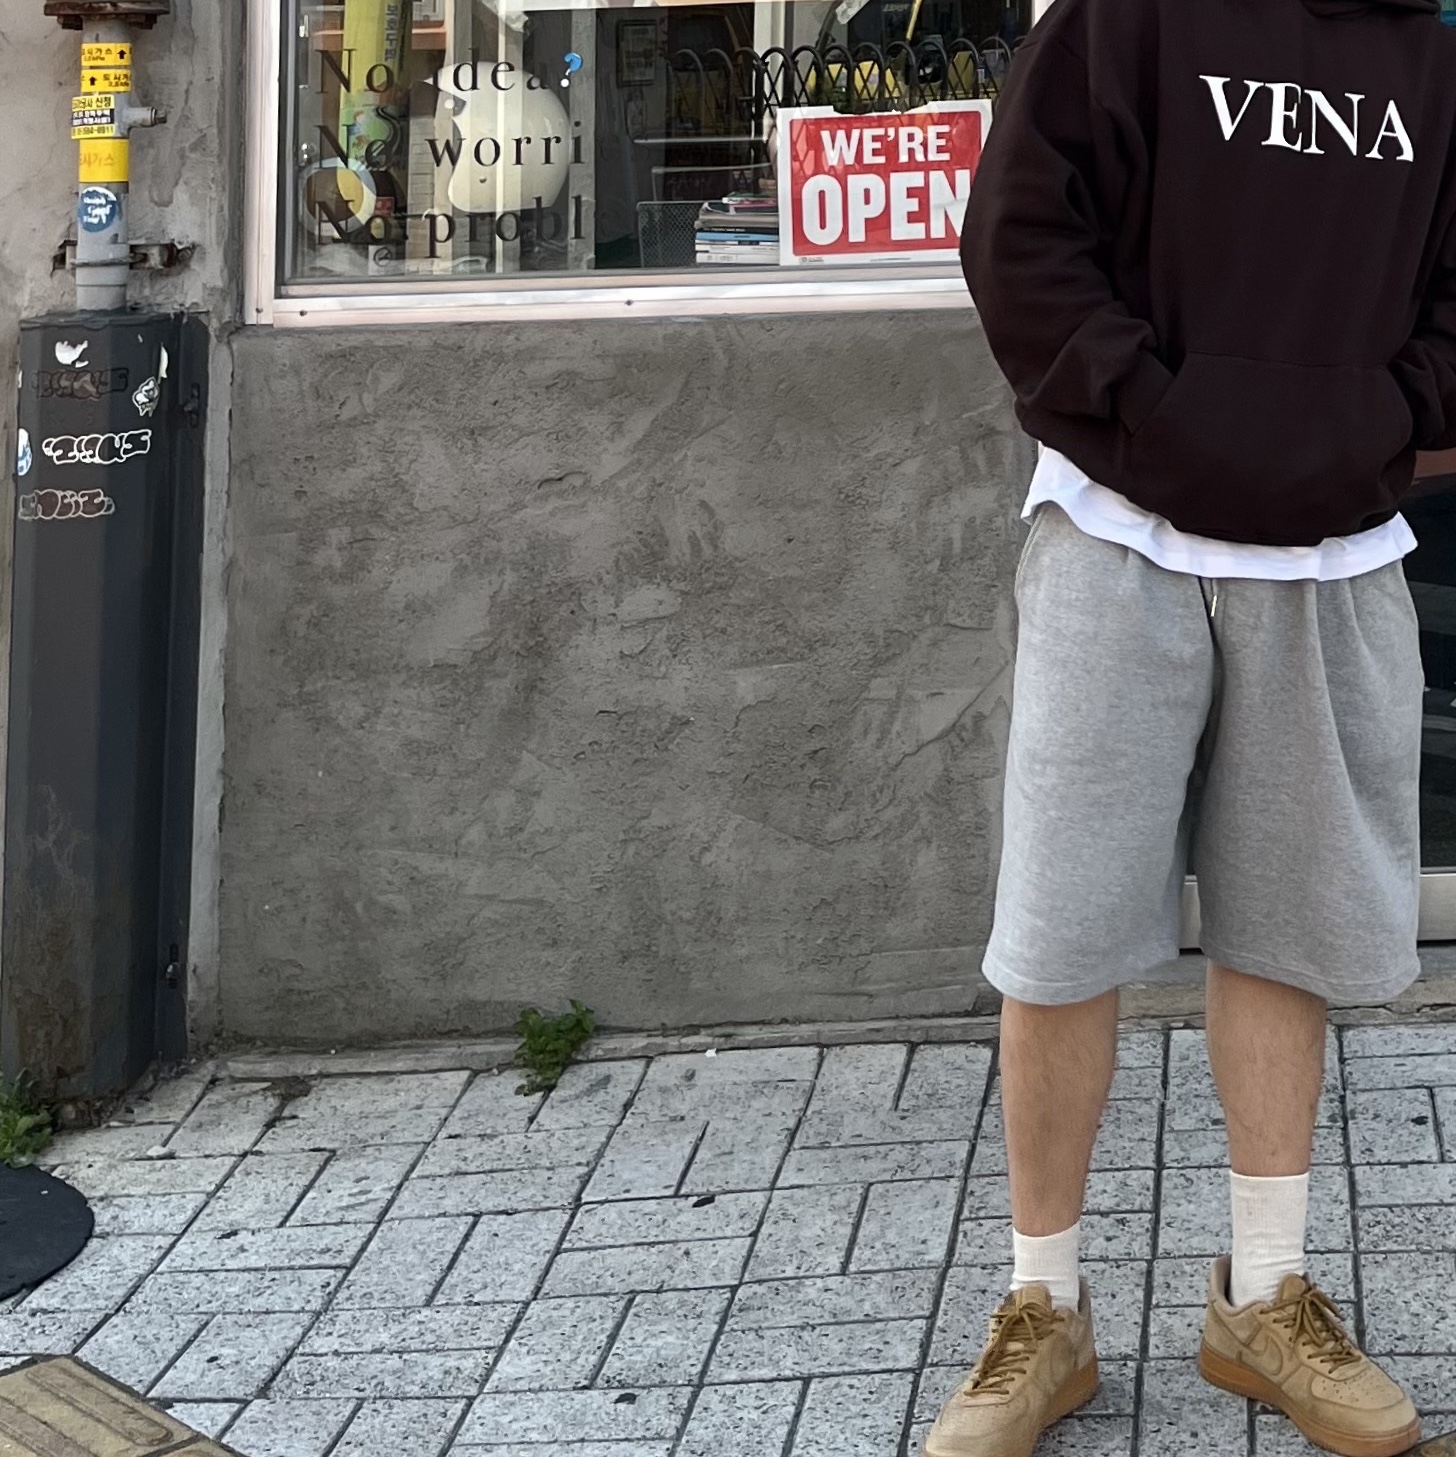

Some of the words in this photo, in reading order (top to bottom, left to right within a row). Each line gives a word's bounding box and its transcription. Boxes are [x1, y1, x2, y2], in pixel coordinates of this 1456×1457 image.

[315, 48, 394, 94] No
[424, 120, 586, 169] worri
[820, 124, 951, 166] WE'RE
[1199, 75, 1414, 162] VENA
[422, 195, 586, 259] probl
[801, 169, 971, 246] OPEN
